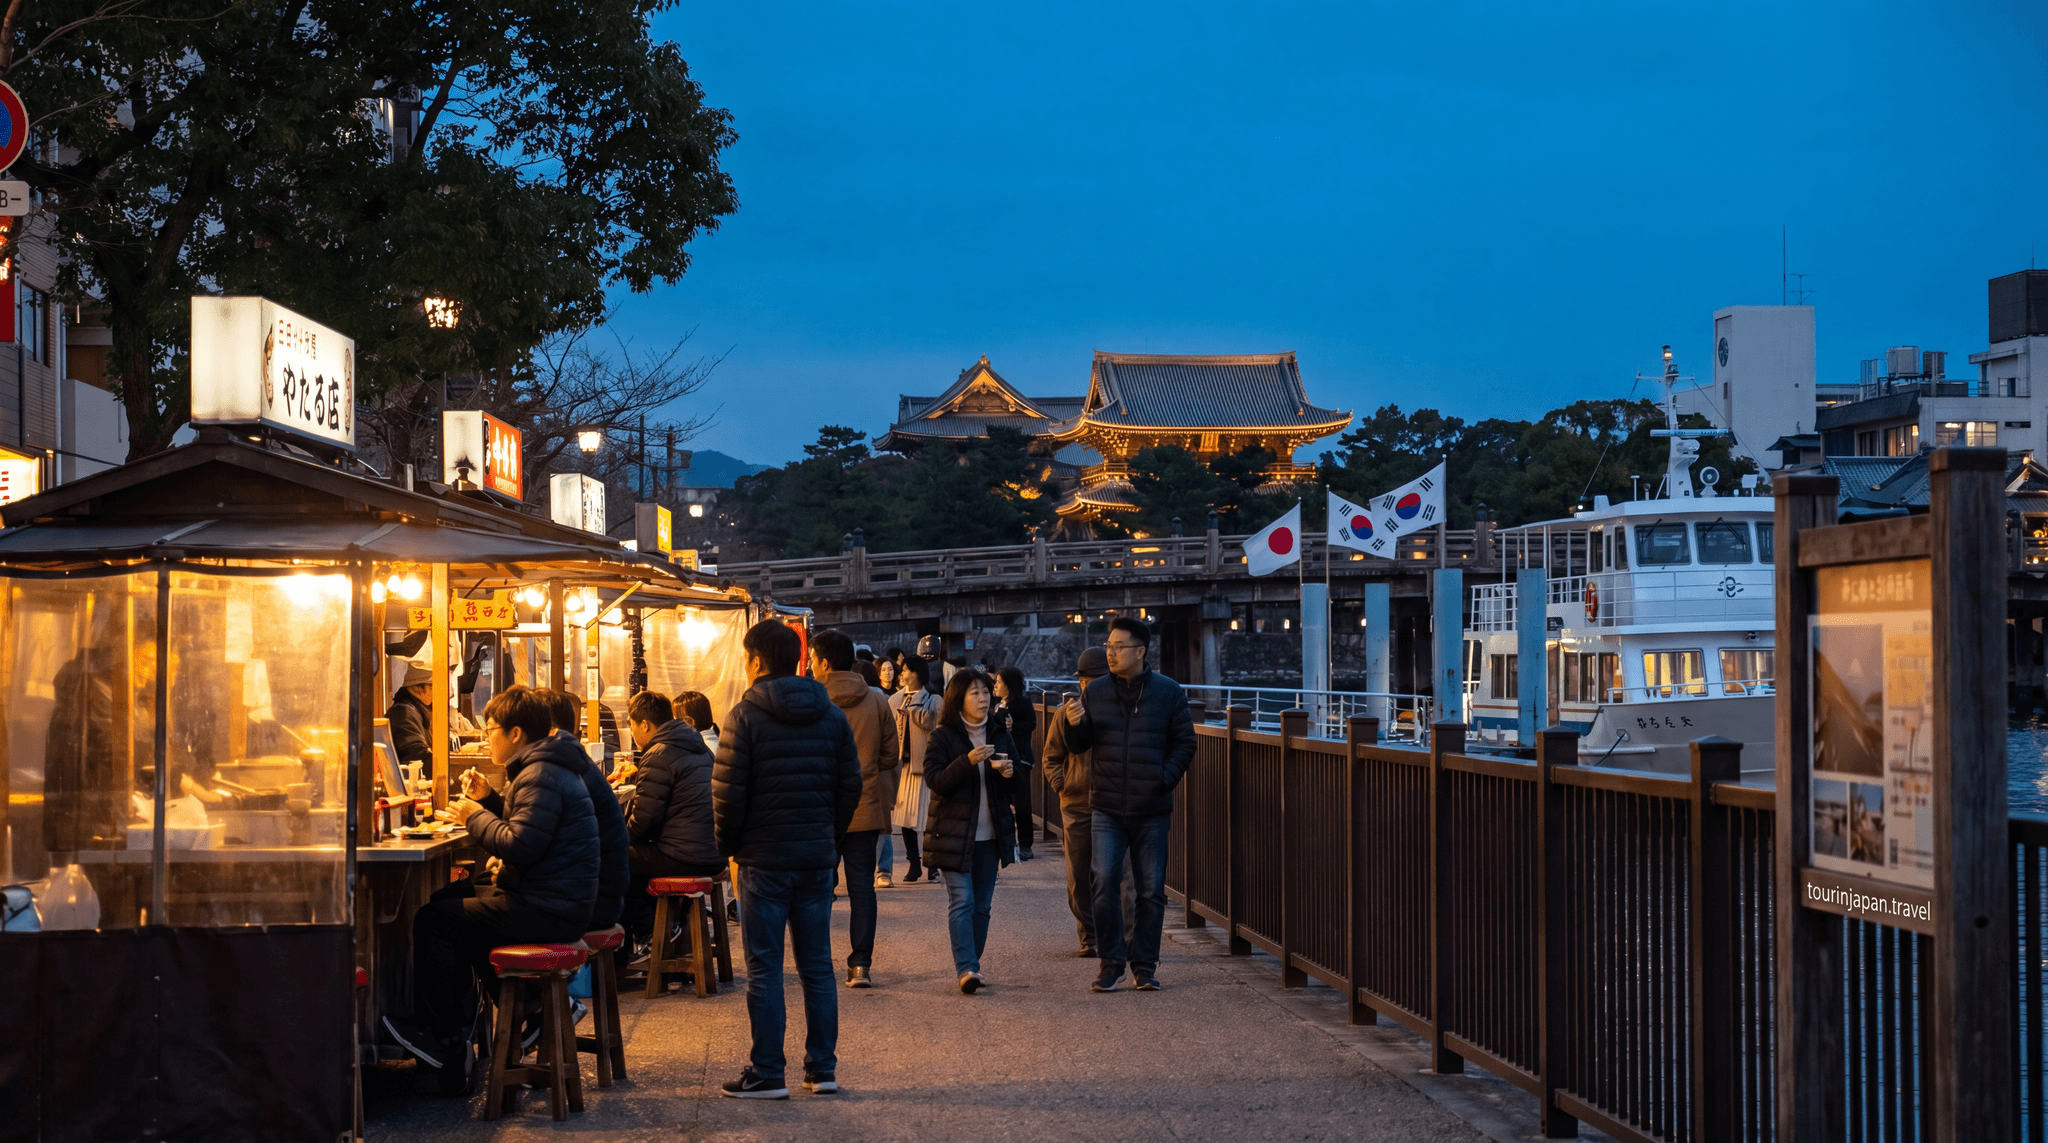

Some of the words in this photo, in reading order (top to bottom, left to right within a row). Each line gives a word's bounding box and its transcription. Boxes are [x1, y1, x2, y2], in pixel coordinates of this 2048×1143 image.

[282, 362, 340, 432] やたる店
[1807, 881, 1931, 921] tourinjapan.travel
